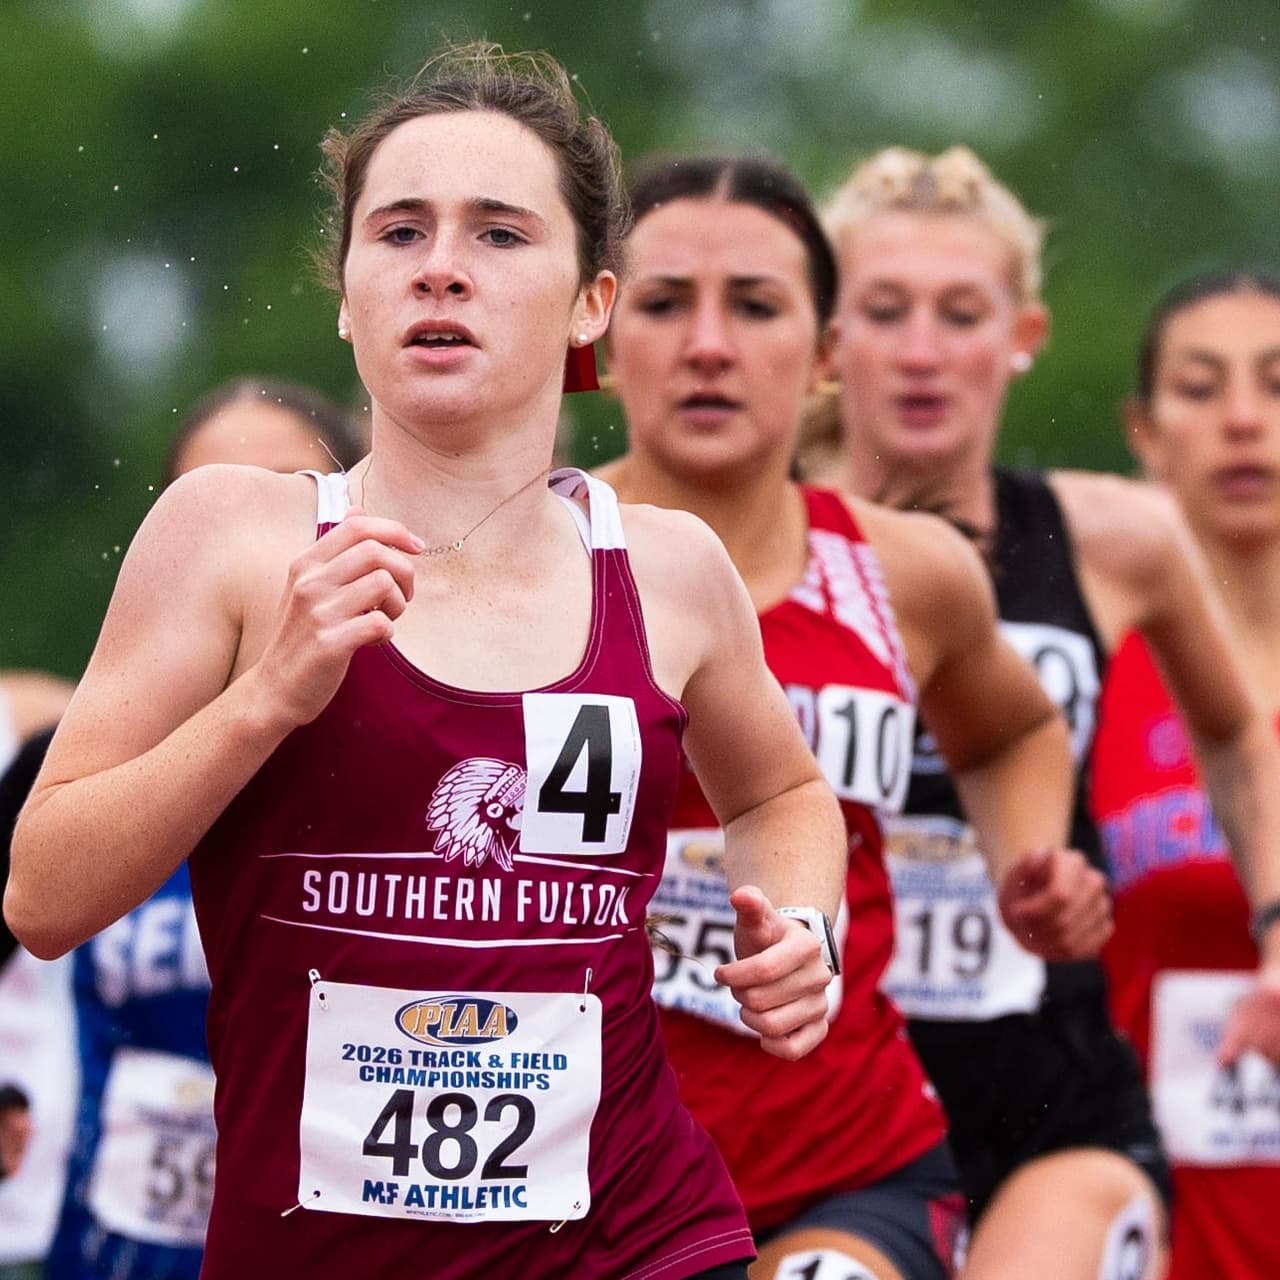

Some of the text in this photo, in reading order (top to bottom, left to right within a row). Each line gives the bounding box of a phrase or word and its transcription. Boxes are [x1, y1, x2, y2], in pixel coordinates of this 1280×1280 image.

[832, 698, 898, 797] 10
[537, 704, 622, 843] 4
[302, 870, 502, 921] SOUTHERN
[517, 879, 629, 927] FULTON
[409, 1002, 510, 1039] PIAA
[342, 1043, 568, 1071] 2026 TRACK & FIELD
[358, 1065, 551, 1090] CHAMPIONSHIPS
[362, 1089, 536, 1181] 482
[403, 1184, 528, 1210] ATHLETIC
